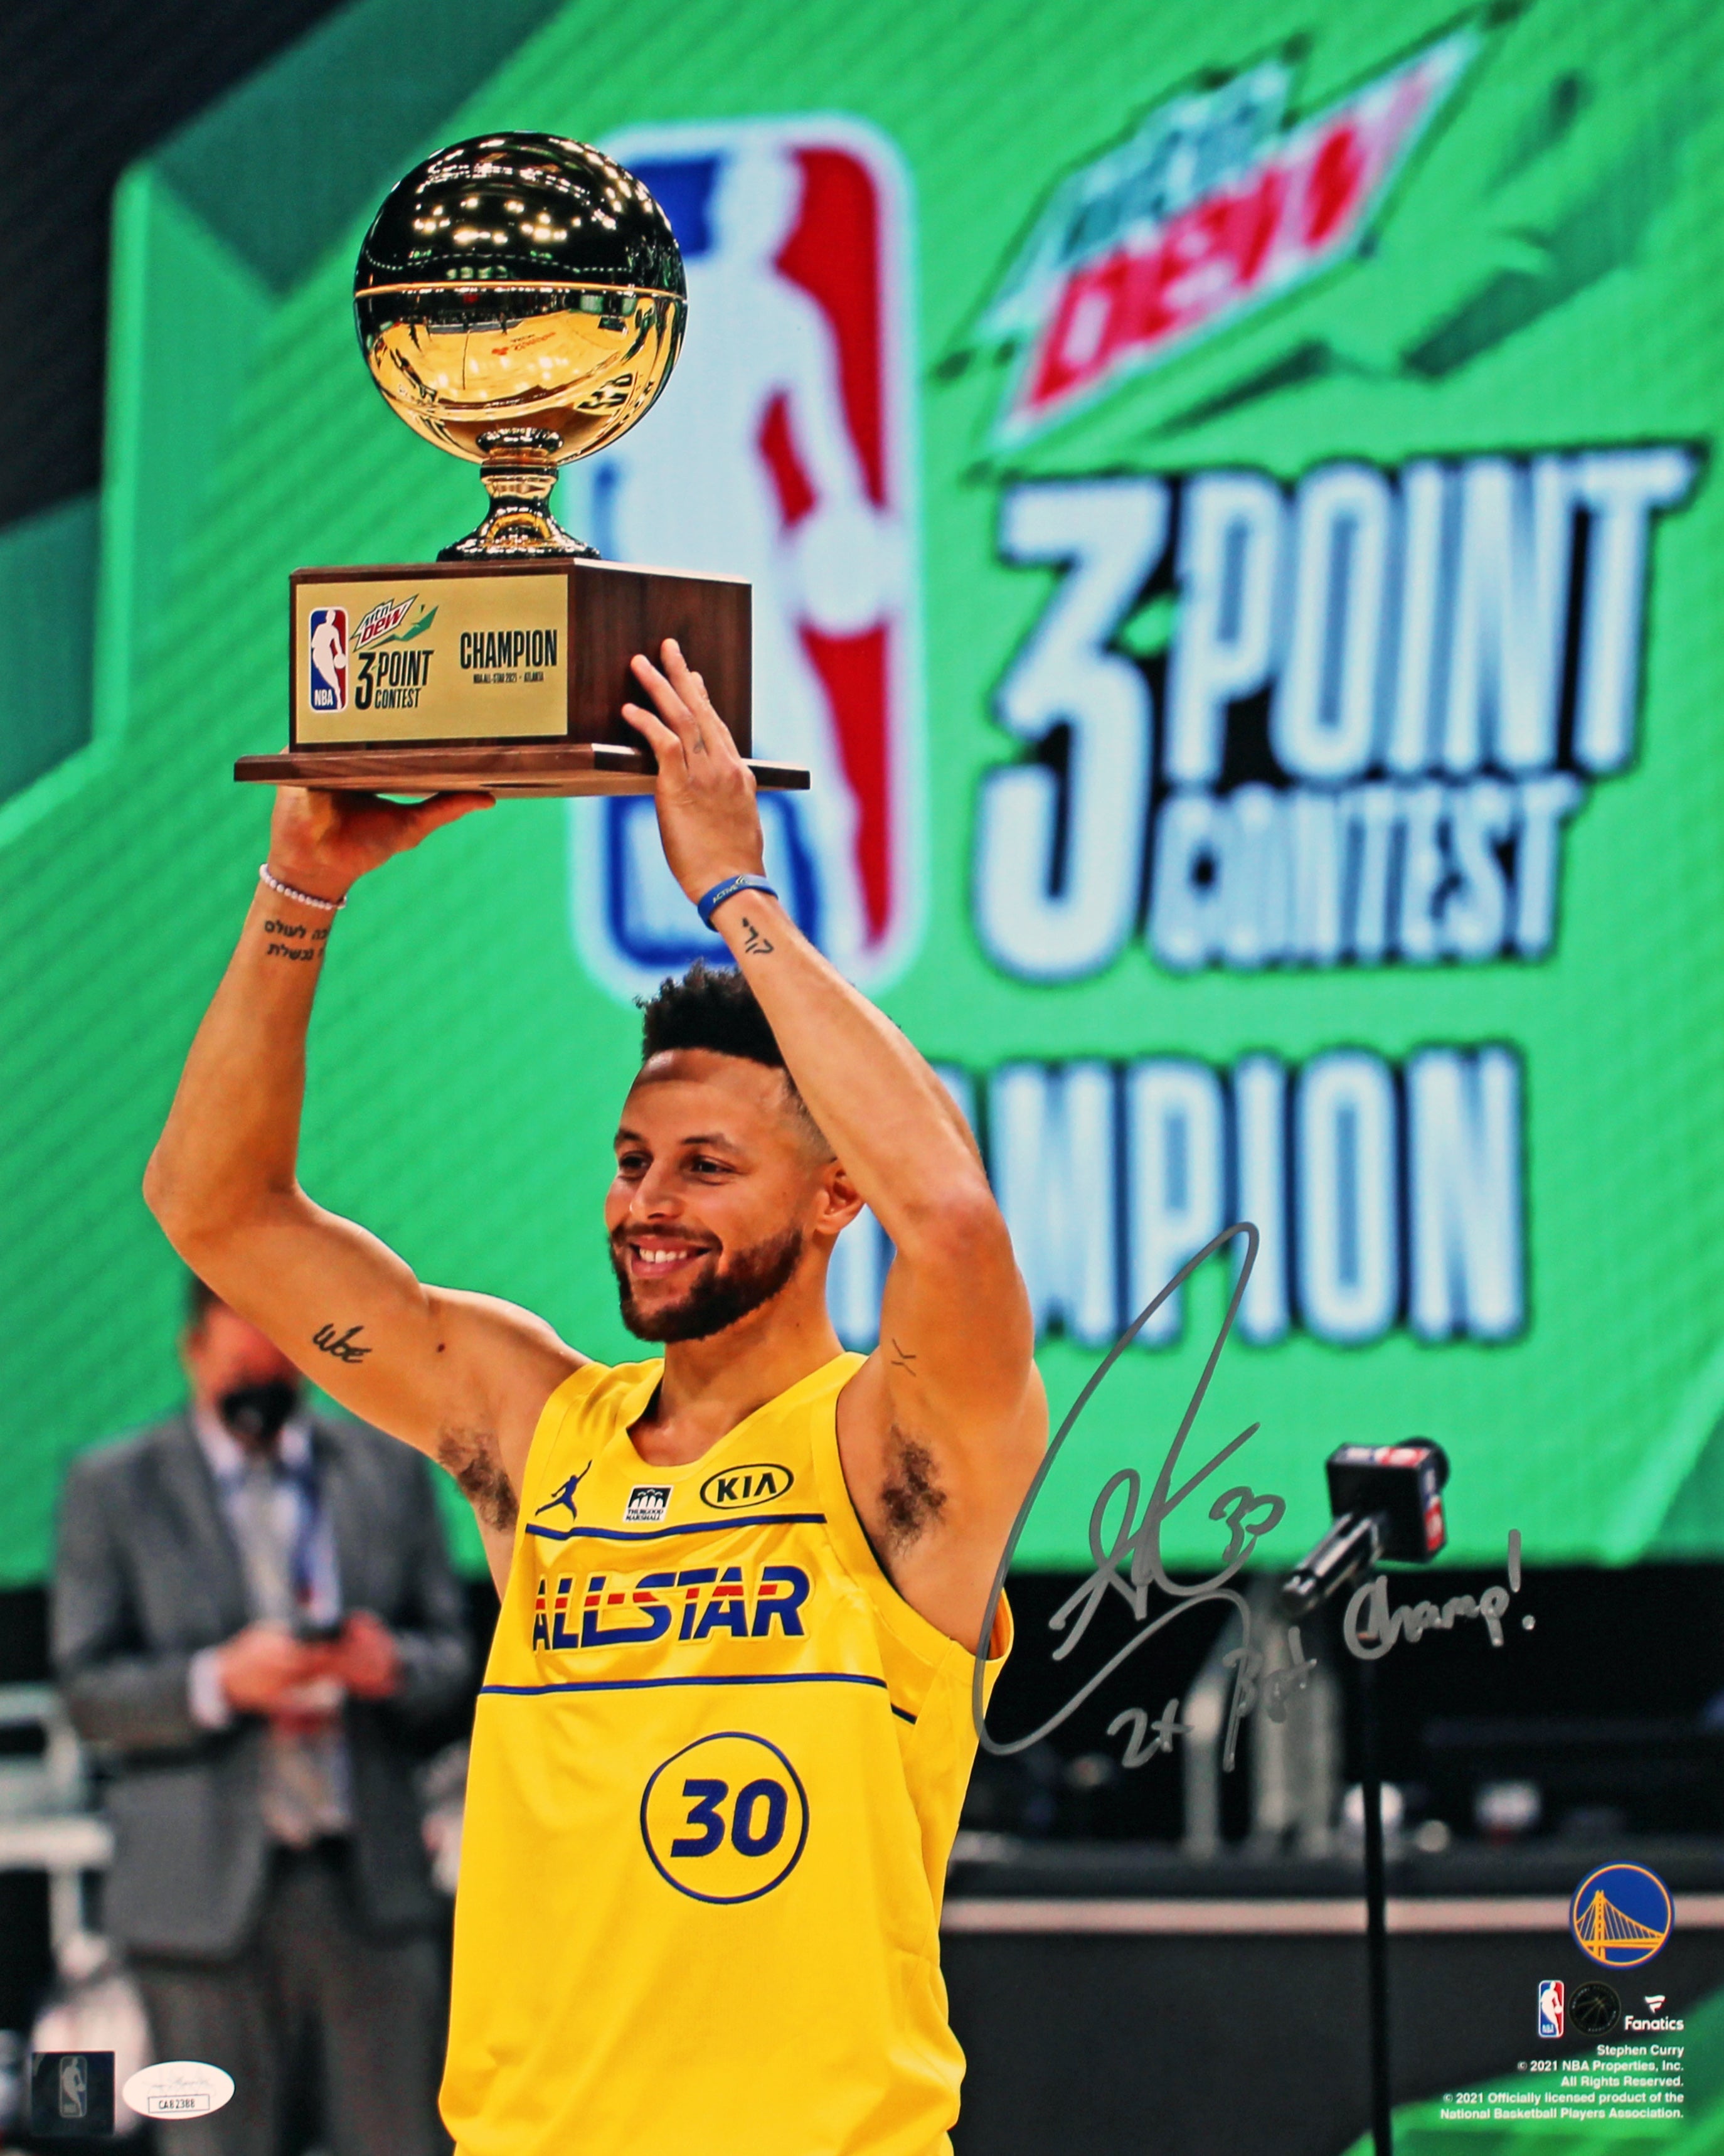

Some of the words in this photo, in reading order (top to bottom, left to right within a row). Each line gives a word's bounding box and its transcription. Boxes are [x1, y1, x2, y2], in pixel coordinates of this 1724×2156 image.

[460, 629, 557, 670] CHAMPION
[314, 689, 333, 707] NBA
[354, 651, 376, 710] 3
[376, 649, 434, 687] POINT
[375, 688, 422, 709] CONTEST
[979, 481, 1174, 974] 3
[1167, 452, 1700, 781] POINT
[717, 1473, 777, 1503] KIA
[670, 1778, 789, 1857] 30
